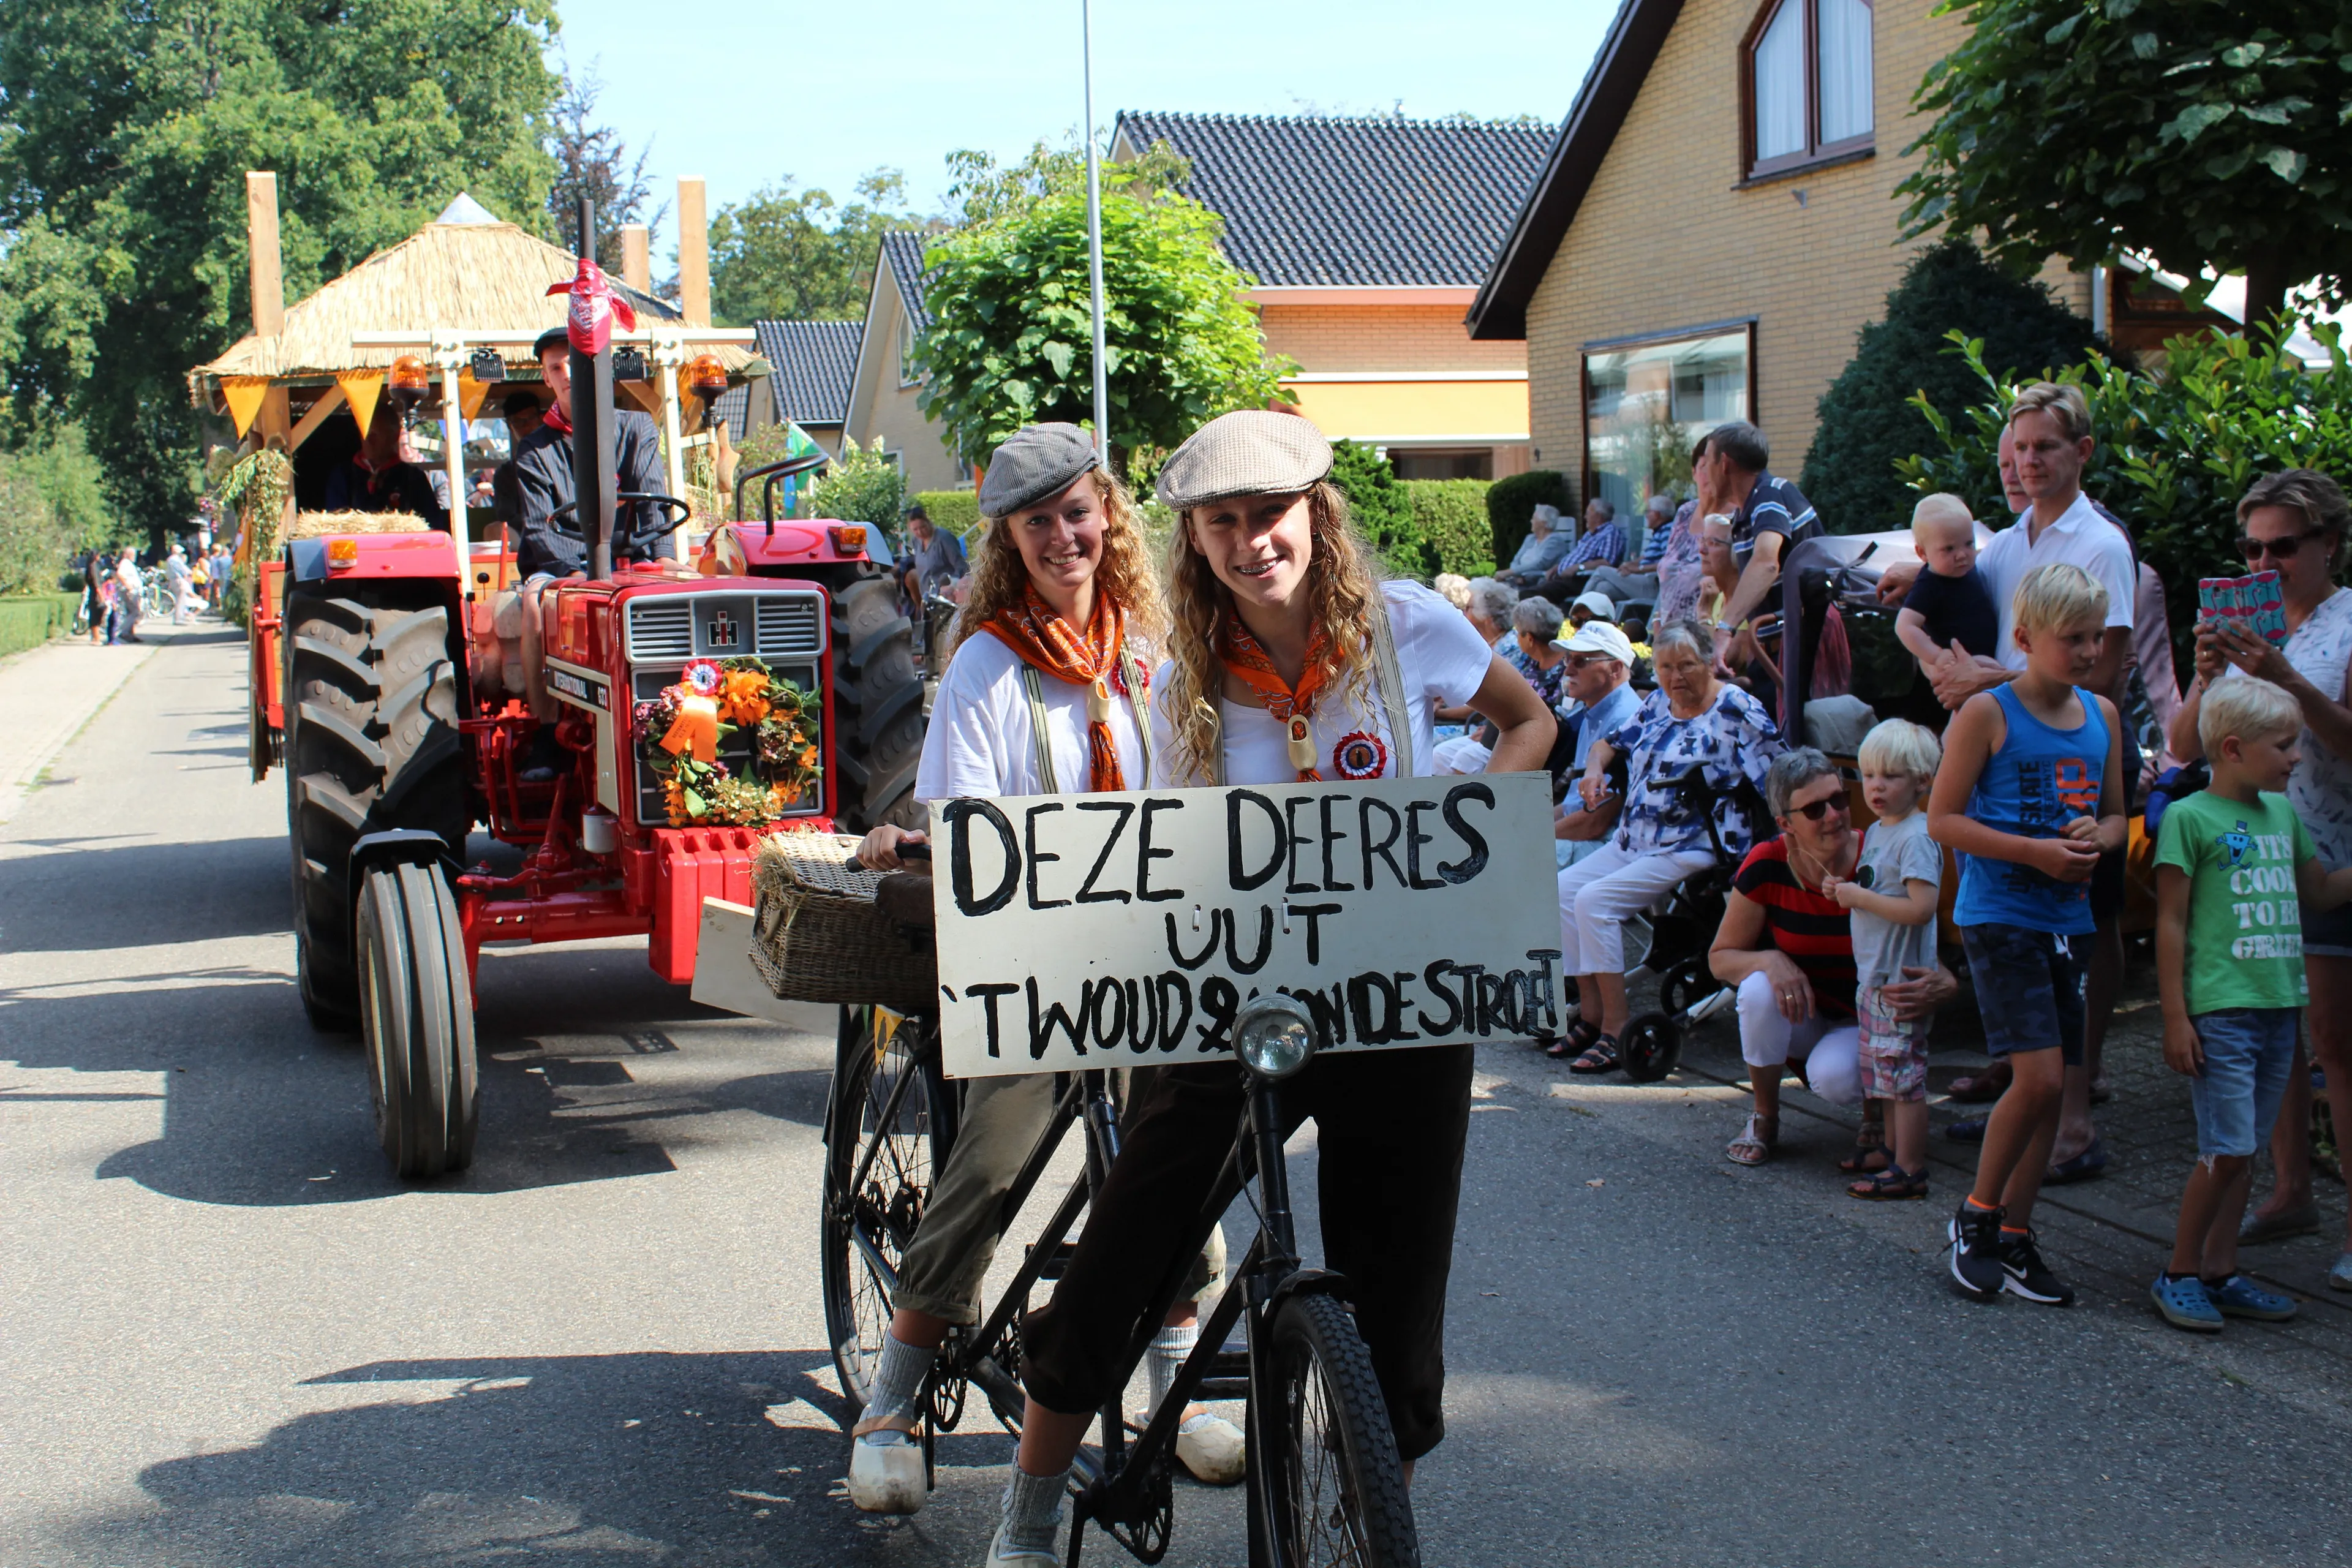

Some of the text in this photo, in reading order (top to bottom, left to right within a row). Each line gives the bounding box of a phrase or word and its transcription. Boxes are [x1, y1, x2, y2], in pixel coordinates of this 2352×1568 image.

[942, 782, 1495, 917] DEZE DEERES
[2231, 865, 2296, 895] COOL
[1165, 903, 1343, 975] UUT
[2232, 900, 2275, 929] TO
